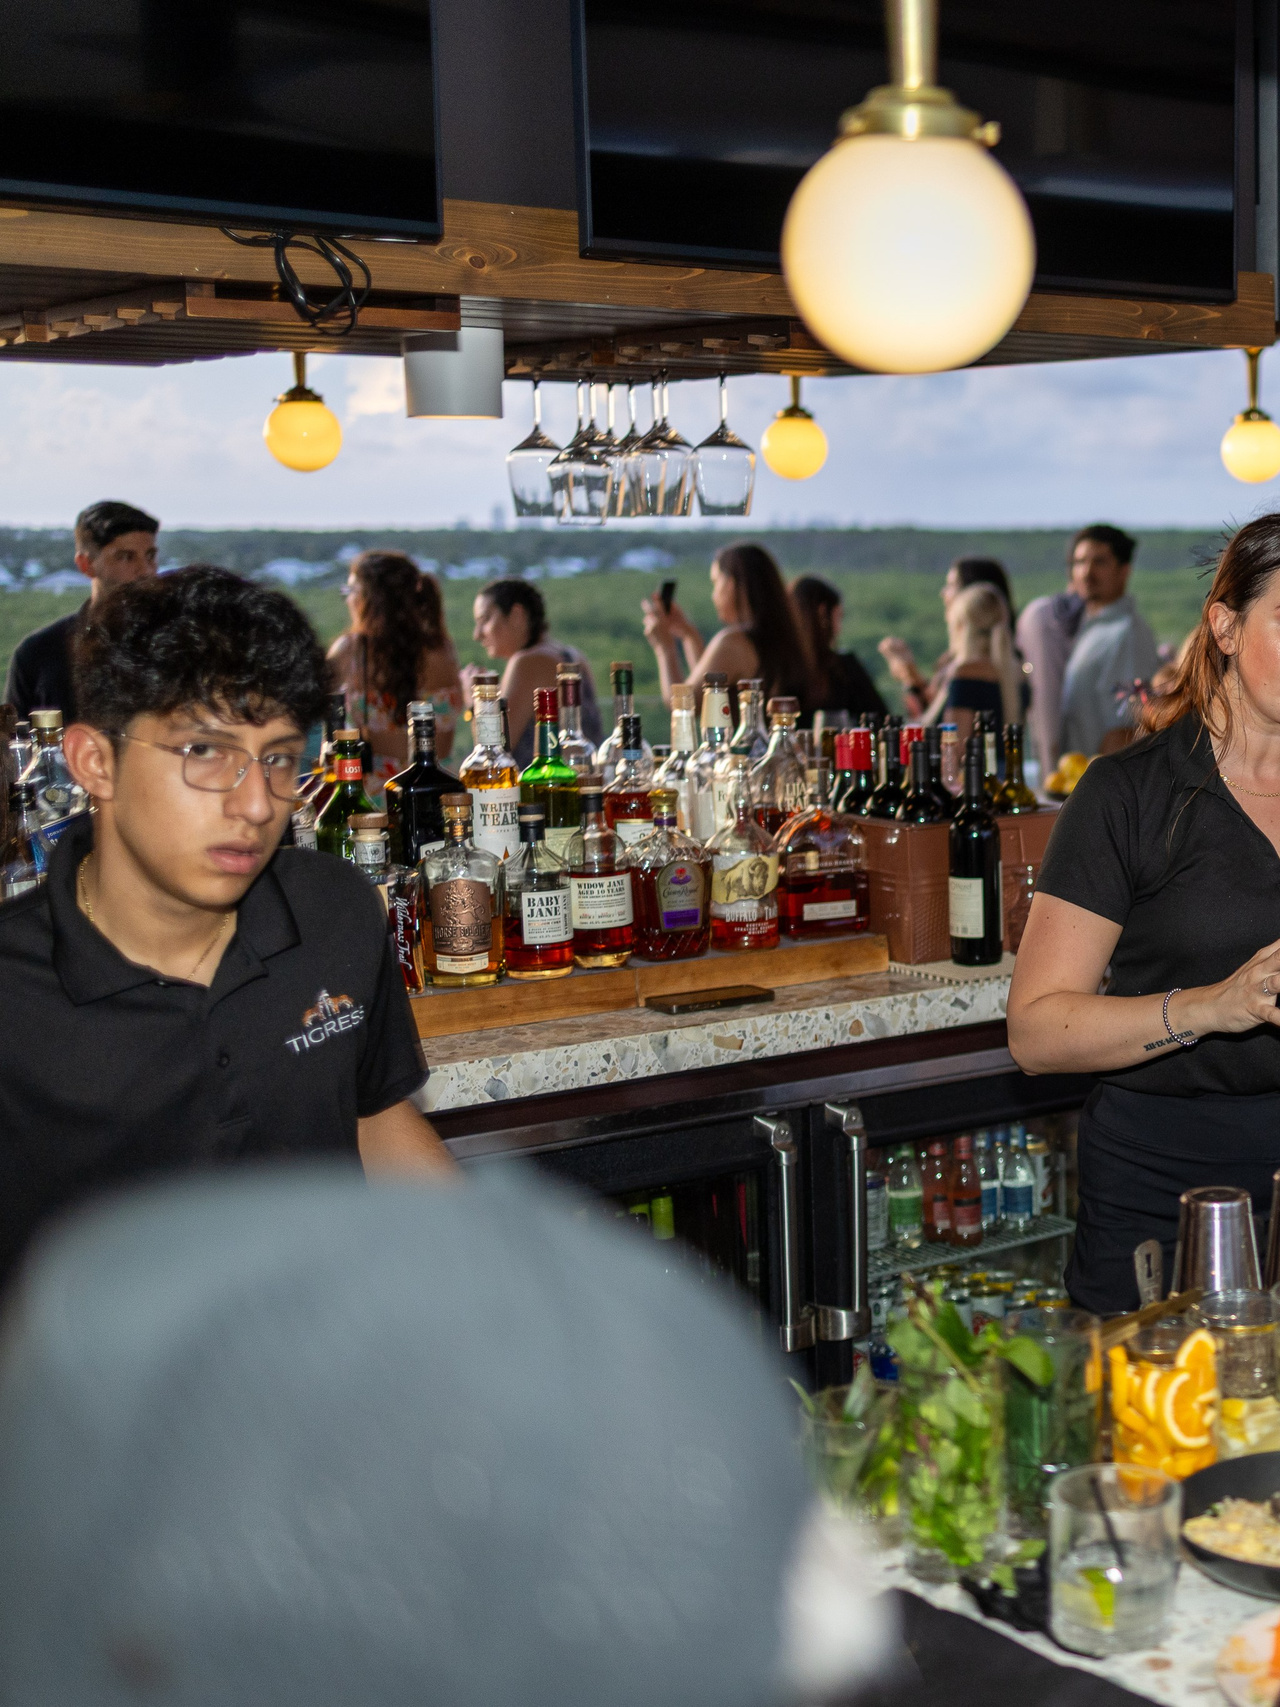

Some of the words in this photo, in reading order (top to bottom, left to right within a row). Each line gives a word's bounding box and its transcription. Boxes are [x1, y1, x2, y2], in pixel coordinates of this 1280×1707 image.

[480, 801, 521, 813] WRITER
[480, 812, 518, 826] TEAR
[607, 879, 625, 888] JANE
[607, 886, 625, 894] YEARS
[527, 895, 560, 907] BABY
[527, 906, 561, 918] JANE
[725, 908, 757, 922] BUFFALO
